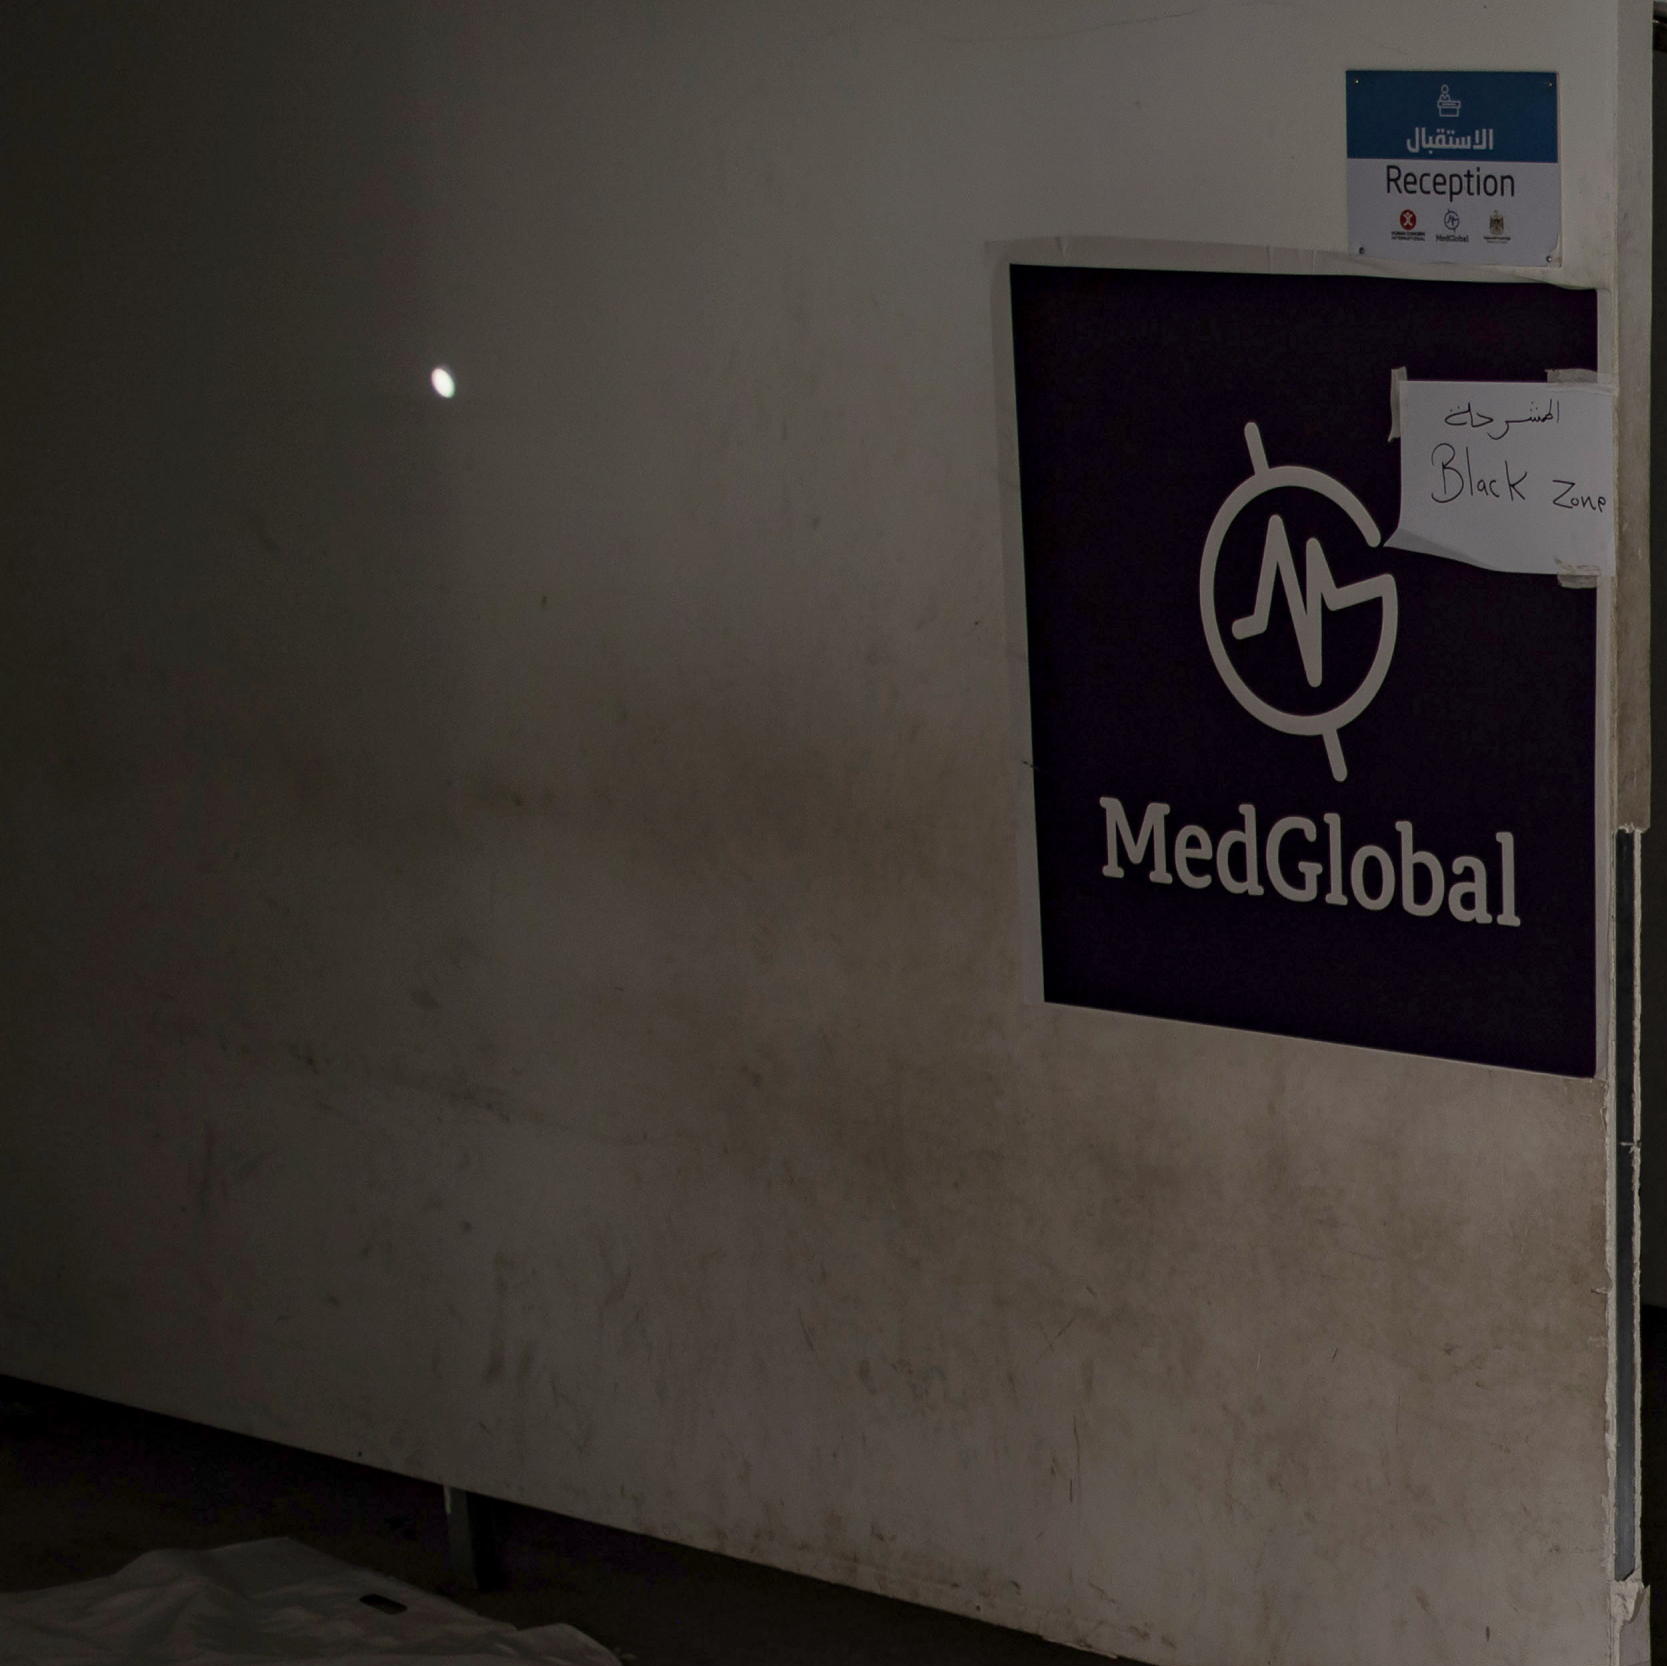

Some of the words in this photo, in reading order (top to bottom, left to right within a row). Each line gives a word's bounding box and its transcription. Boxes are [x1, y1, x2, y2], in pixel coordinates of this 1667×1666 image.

[1405, 127, 1494, 154] الاستقبال
[1386, 165, 1515, 201] Reception
[1444, 399, 1559, 440] المشرحة
[1431, 442, 1527, 503] Black
[1552, 480, 1607, 513] Zone
[1098, 796, 1522, 928] MedGlobal
